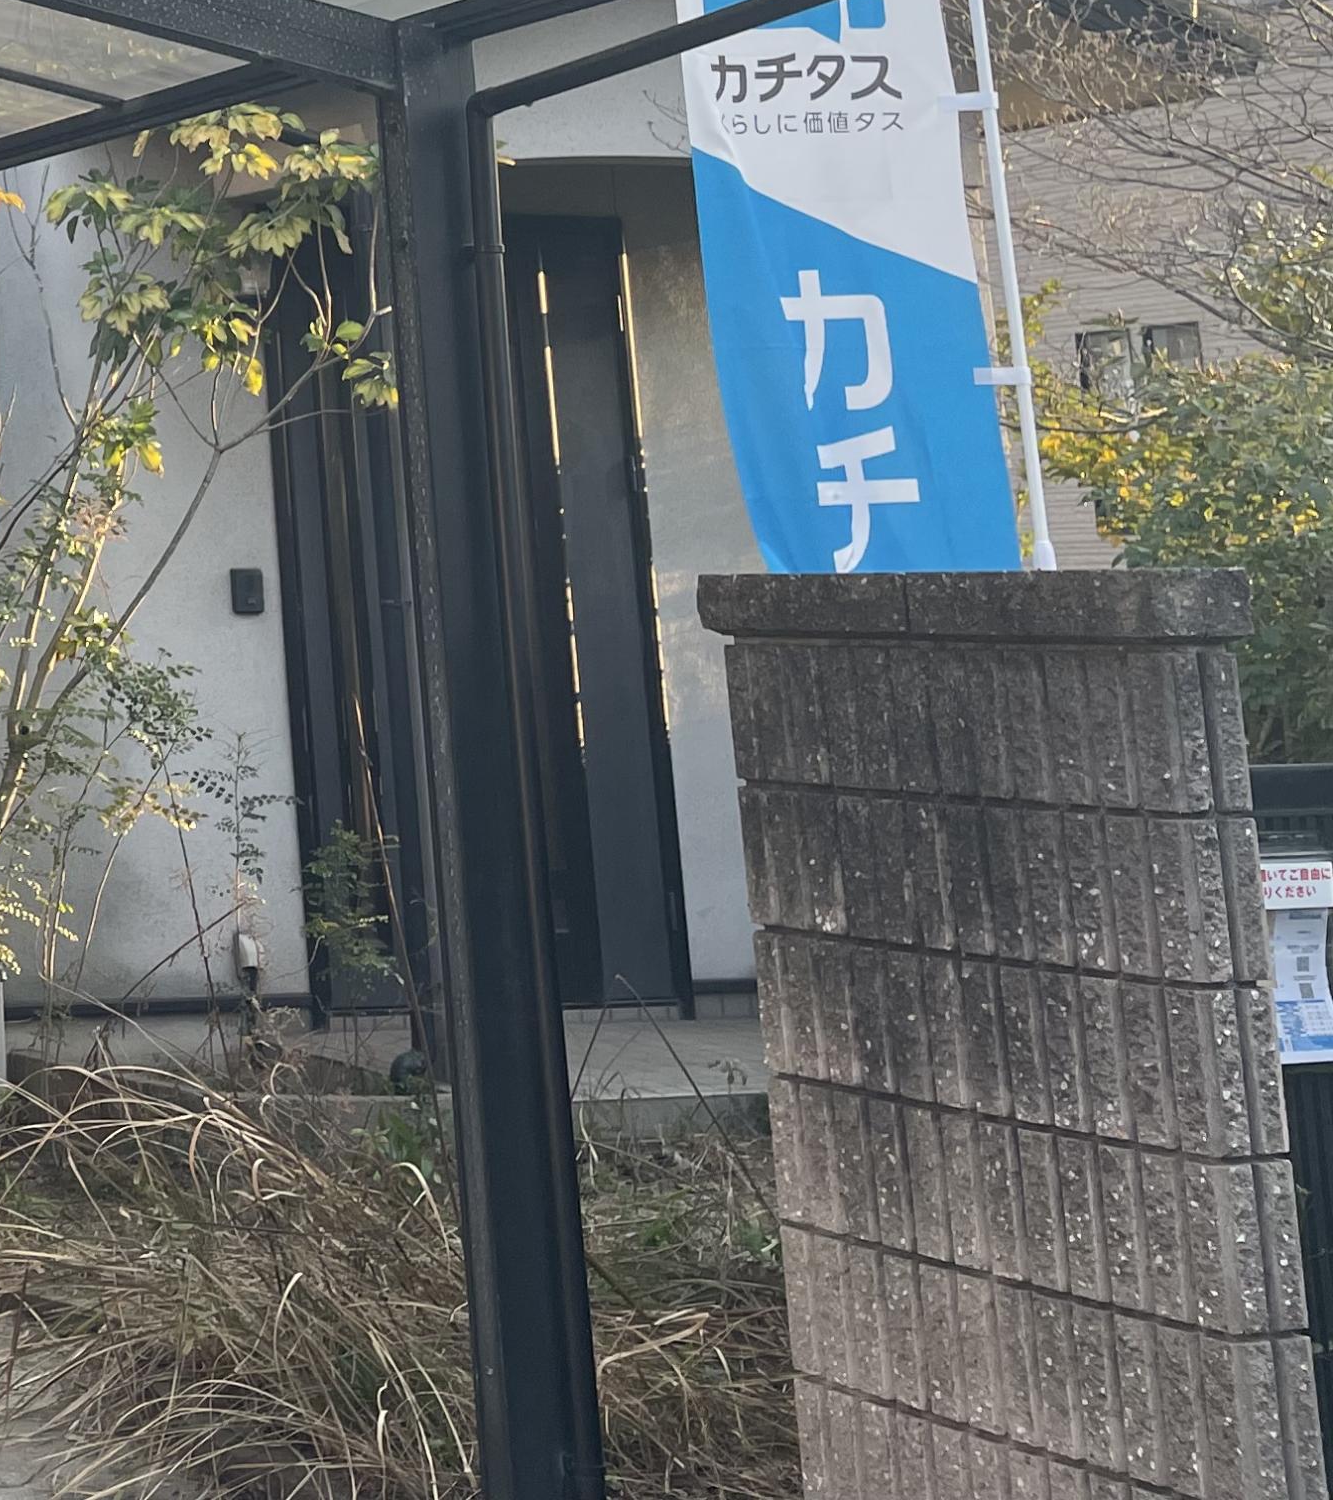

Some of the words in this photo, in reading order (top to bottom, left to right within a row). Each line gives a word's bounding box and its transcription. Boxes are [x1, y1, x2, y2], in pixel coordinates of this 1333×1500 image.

[711, 53, 903, 103] カチタス
[780, 269, 920, 573] カチ
